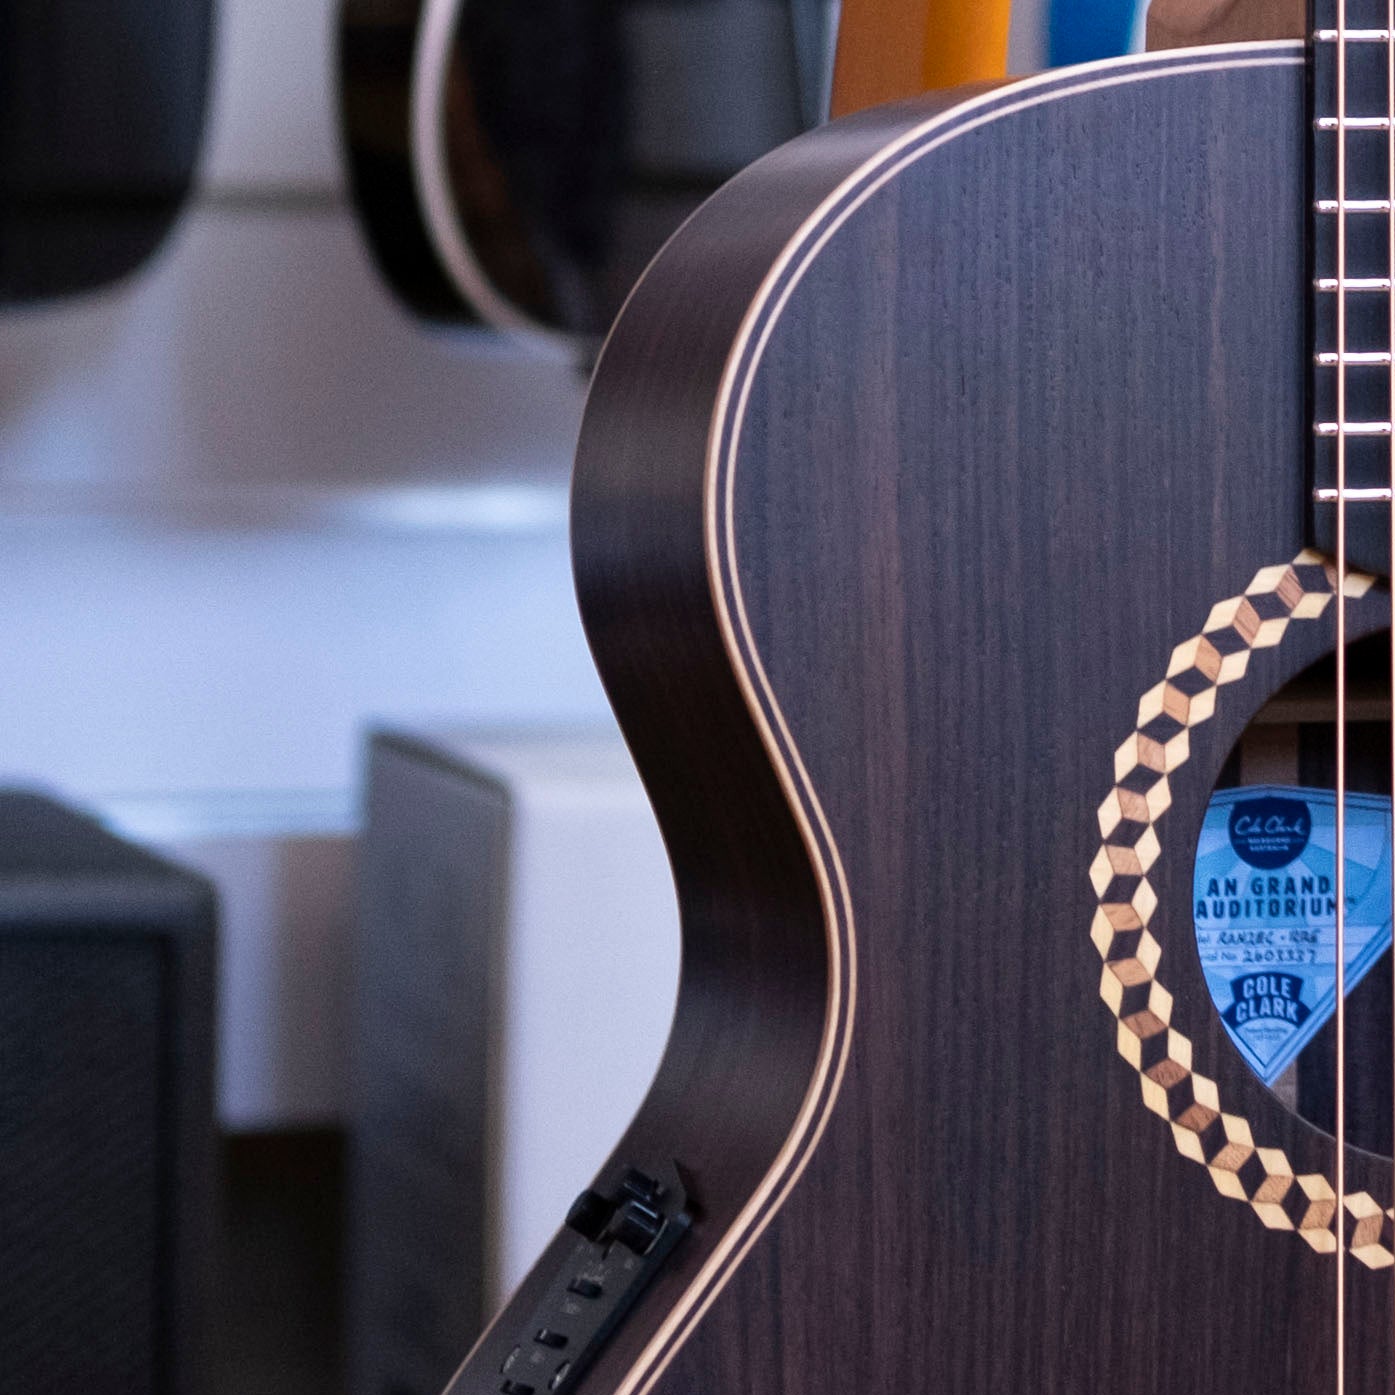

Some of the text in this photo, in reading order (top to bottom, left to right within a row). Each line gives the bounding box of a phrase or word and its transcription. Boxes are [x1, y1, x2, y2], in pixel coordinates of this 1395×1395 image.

[1207, 875, 1331, 896] AN GRAND
[1243, 975, 1292, 999] COLE
[1235, 996, 1299, 1023] CLARK
